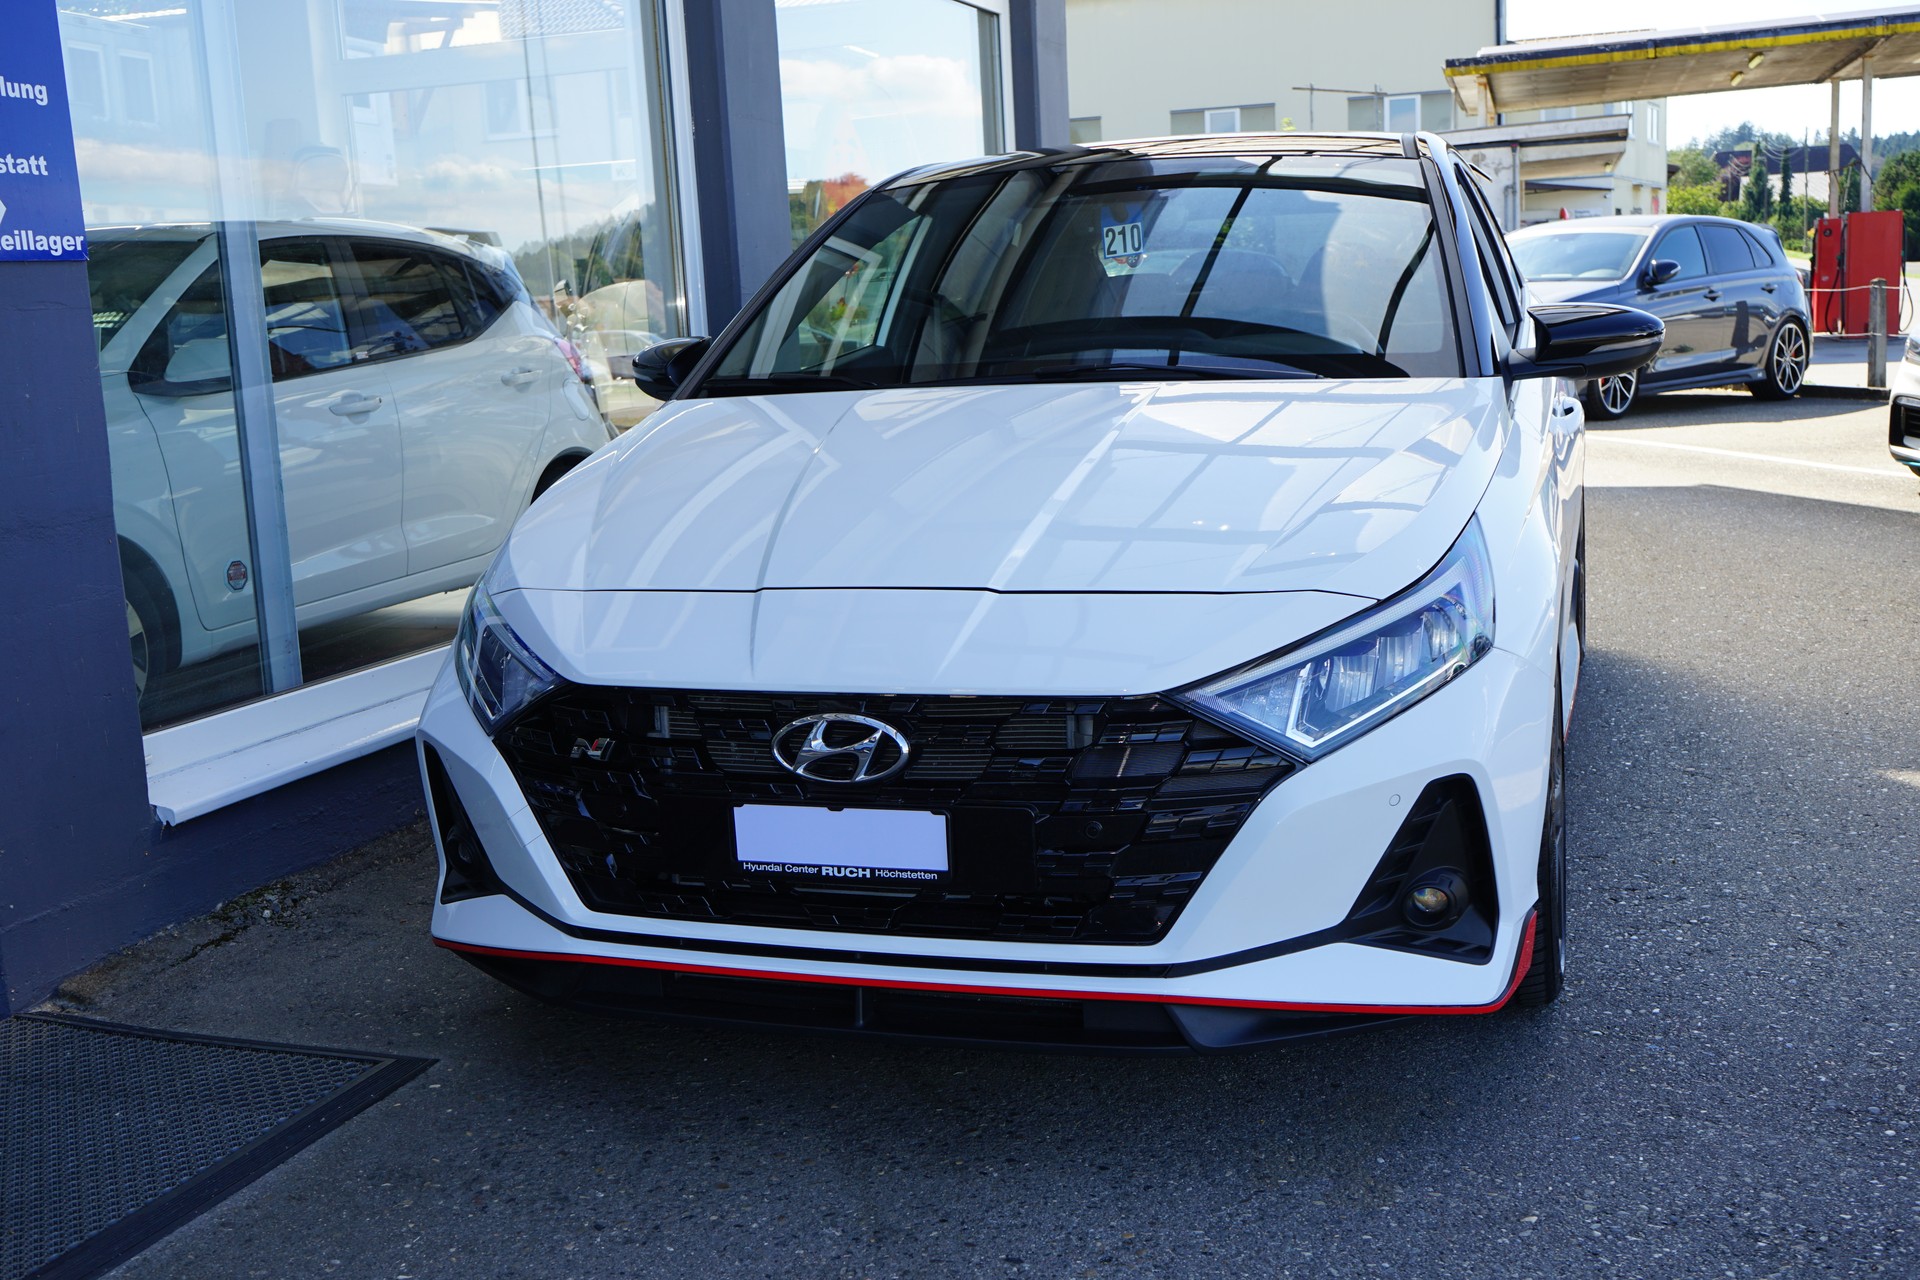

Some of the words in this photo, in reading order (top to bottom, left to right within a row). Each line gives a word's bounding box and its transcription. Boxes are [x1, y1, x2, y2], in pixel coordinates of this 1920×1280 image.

[0, 153, 48, 176] statt
[0, 229, 84, 256] eillager
[1105, 224, 1142, 256] 210
[743, 862, 782, 872] Hyundai
[784, 864, 819, 874] Center
[821, 866, 871, 878] RUCH
[875, 869, 938, 880] Höchstetten
